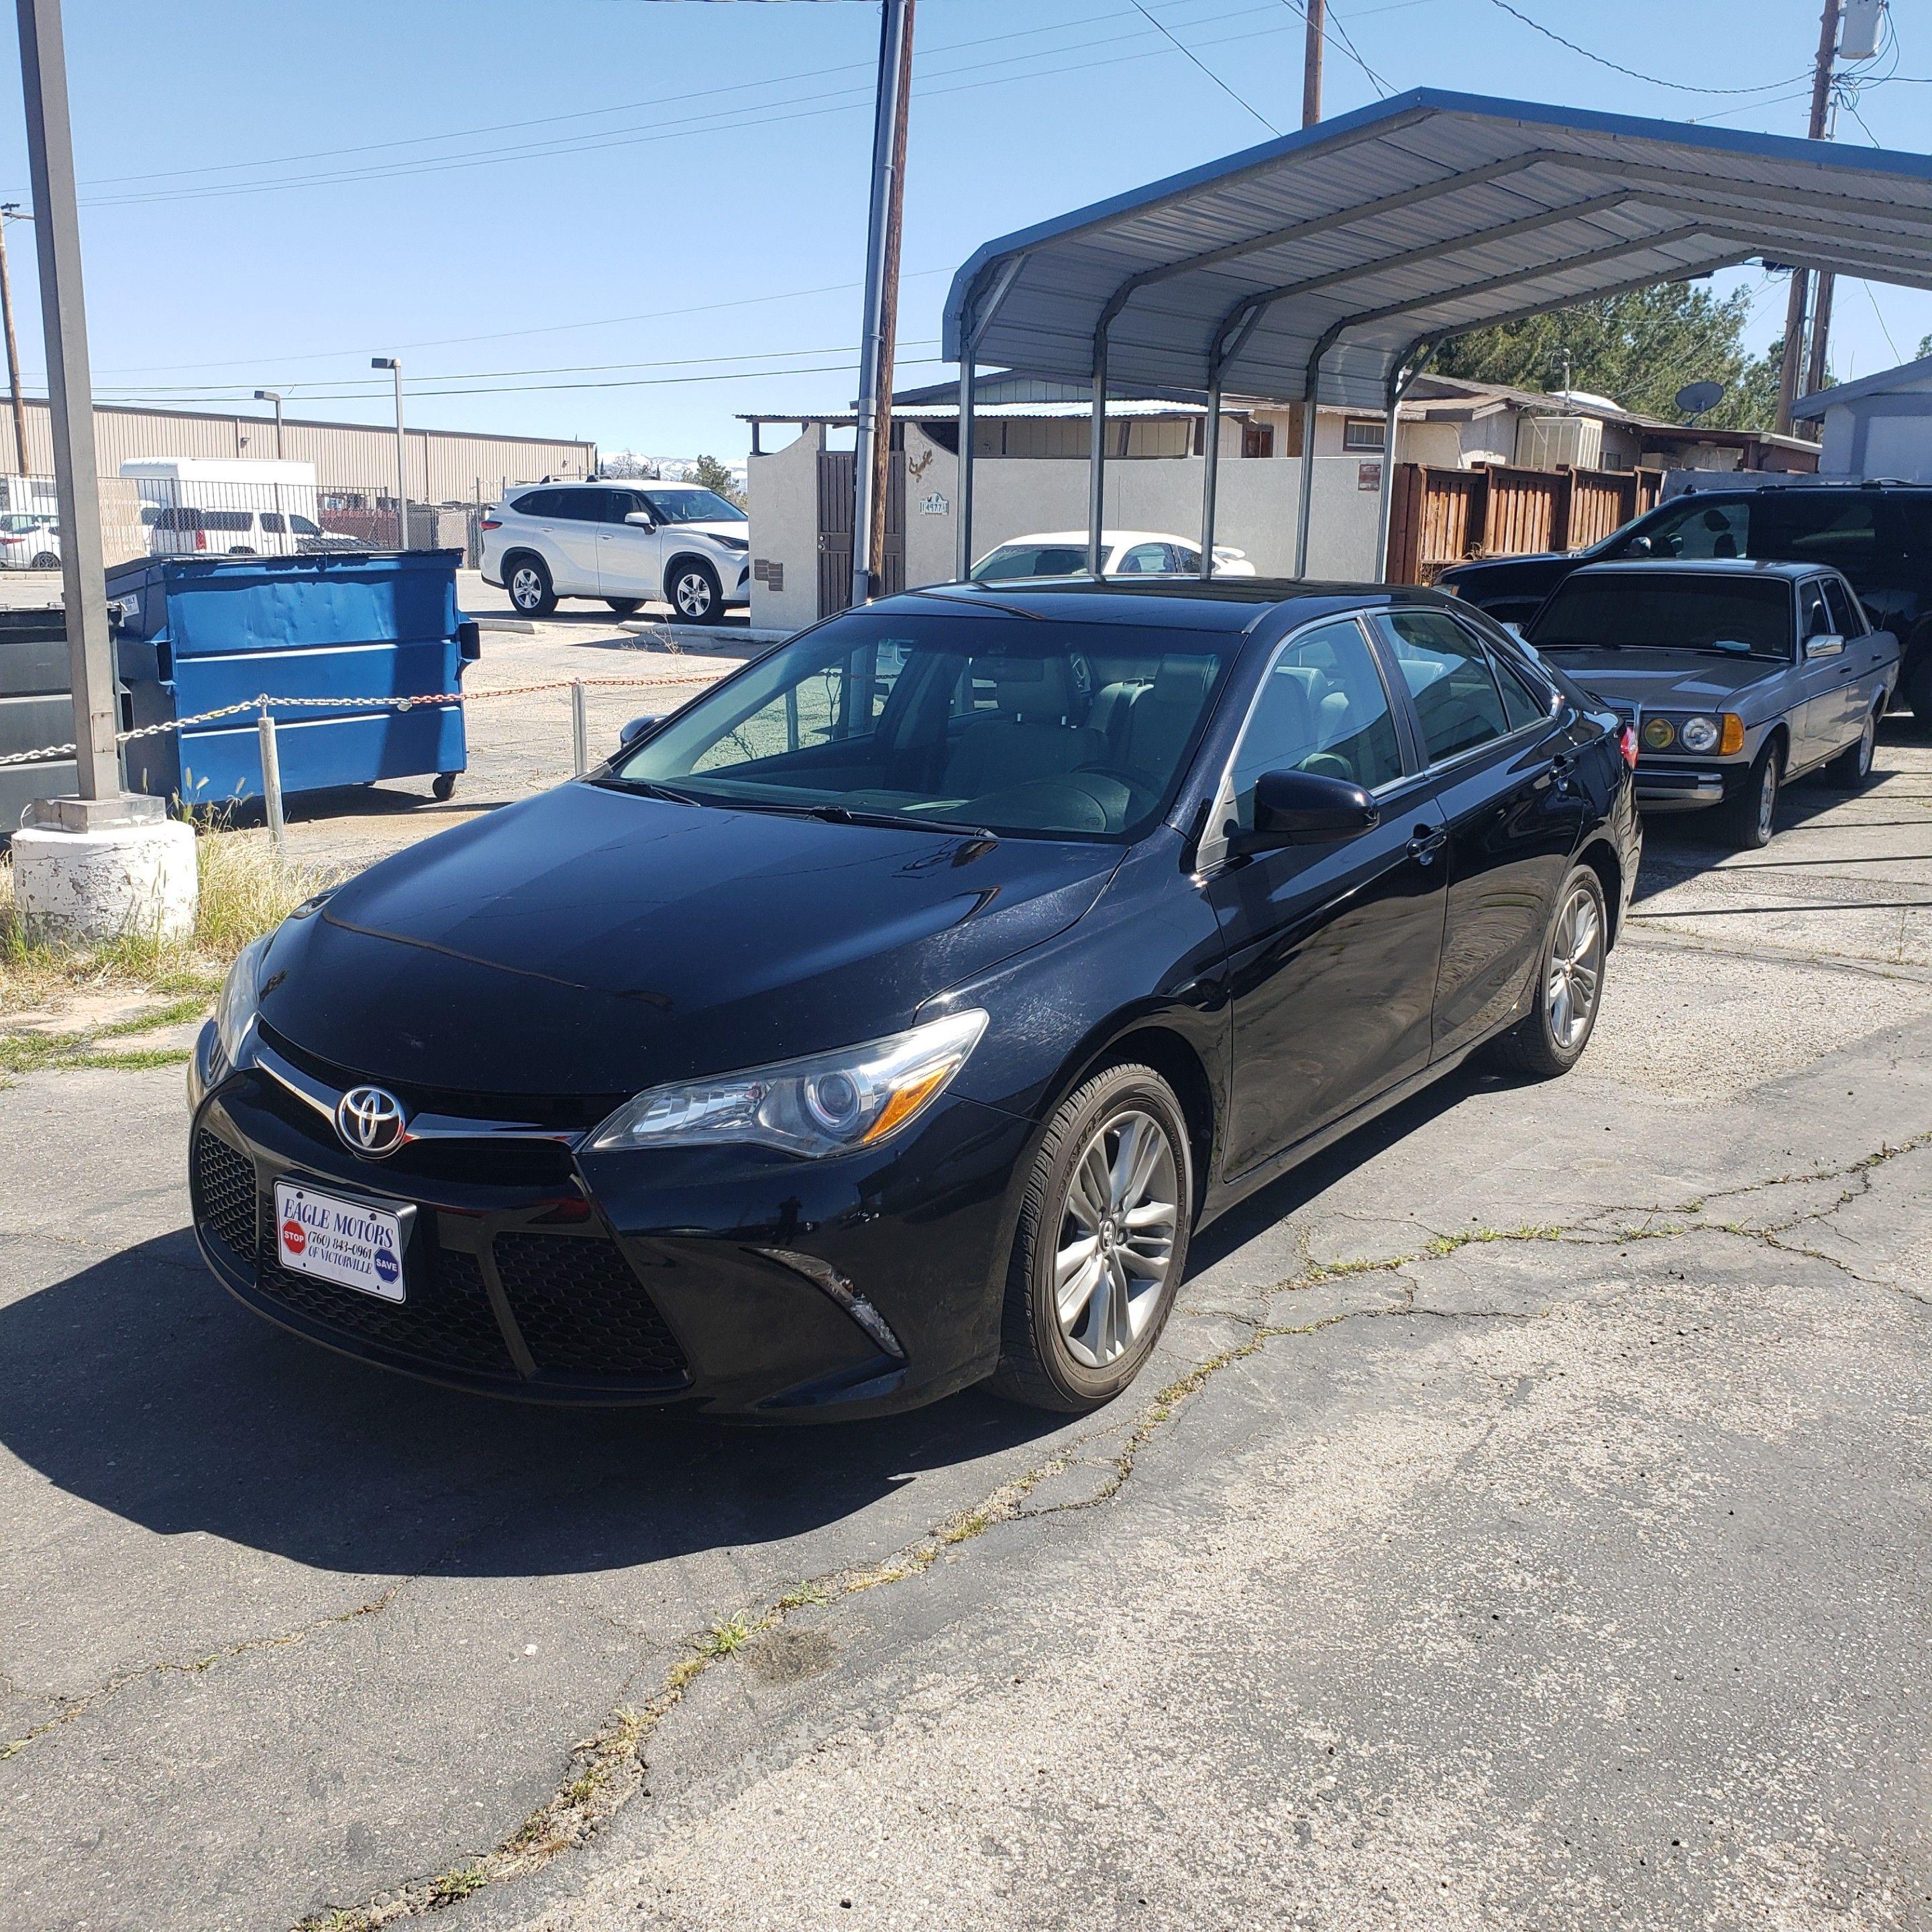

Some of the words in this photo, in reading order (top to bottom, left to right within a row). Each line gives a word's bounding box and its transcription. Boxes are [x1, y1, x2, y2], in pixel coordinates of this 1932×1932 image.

[1057, 1108, 1103, 1203] DUNLOP
[284, 1198, 330, 1230] EAGLE
[333, 1213, 393, 1248] MOTORS
[284, 1230, 304, 1242] STOP
[308, 1230, 330, 1248] (760)
[333, 1238, 372, 1259] 843-0961
[309, 1246, 319, 1257] OF
[321, 1248, 372, 1274] VICTORVILLE
[376, 1258, 397, 1271] SAVE
